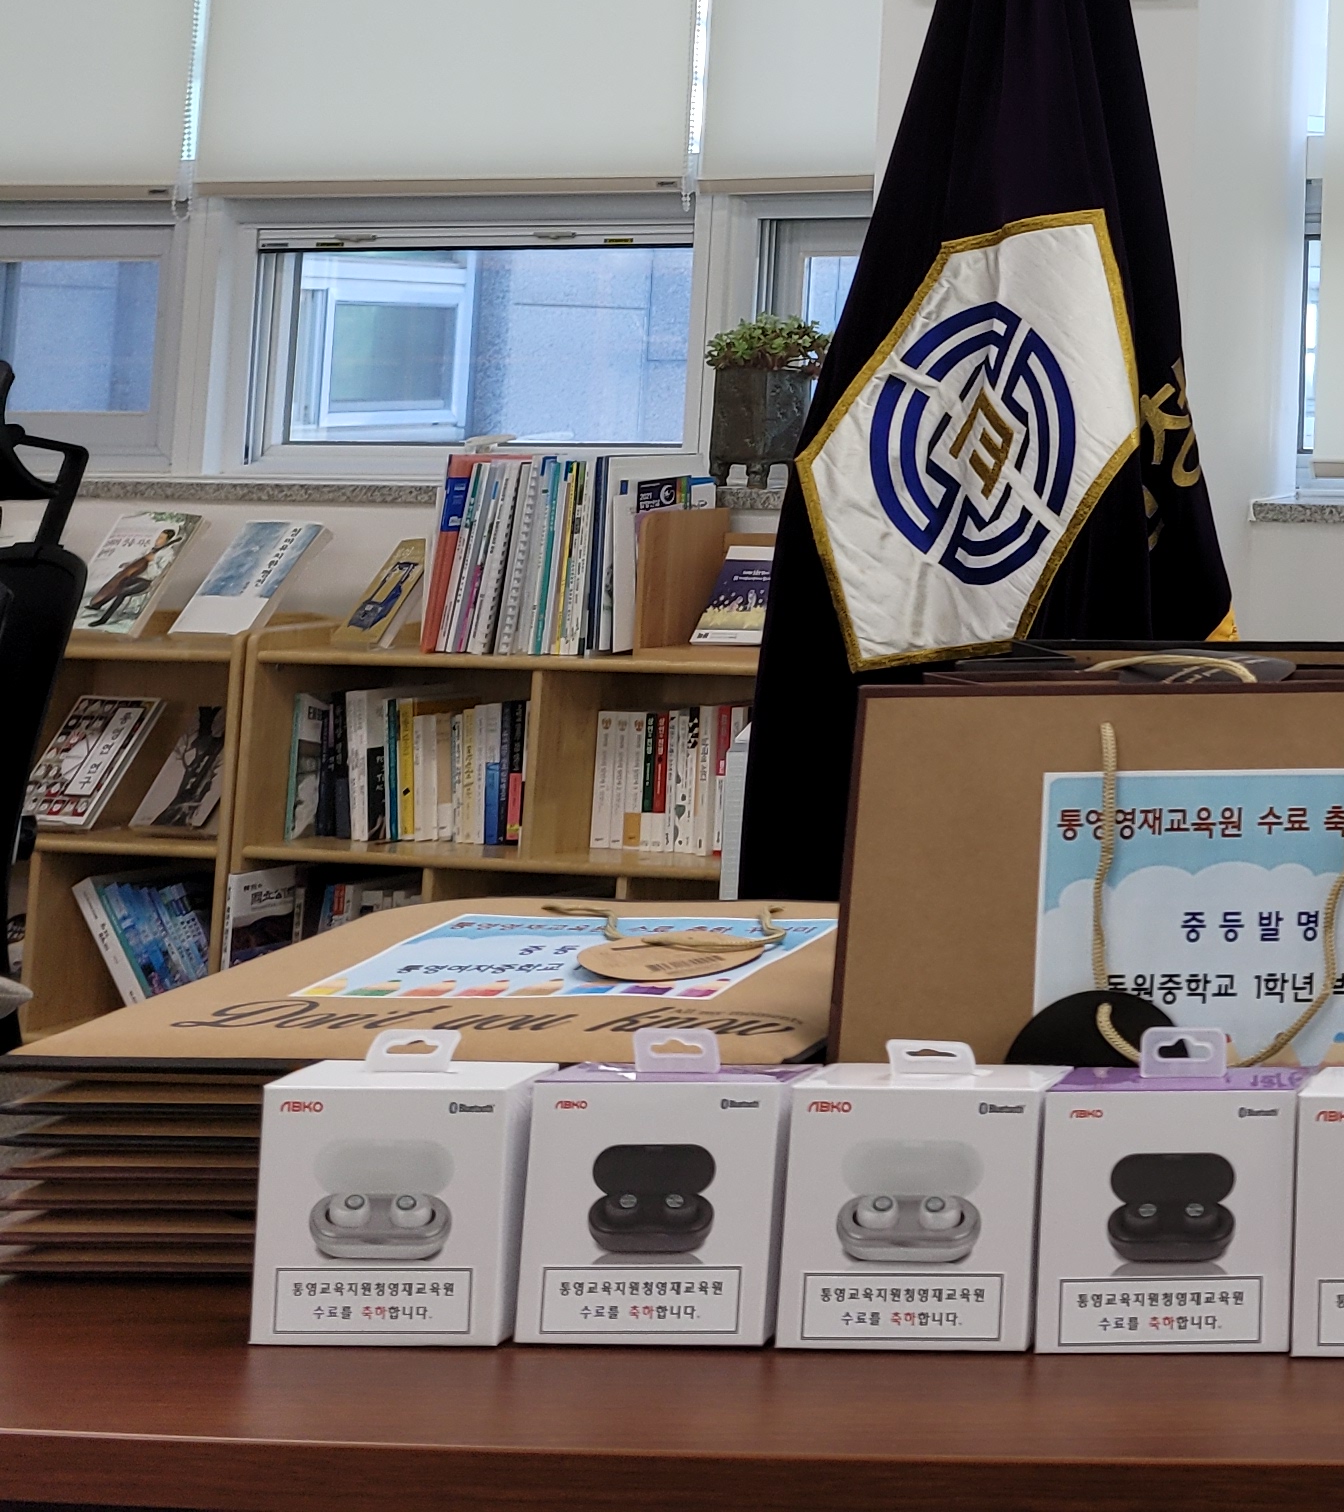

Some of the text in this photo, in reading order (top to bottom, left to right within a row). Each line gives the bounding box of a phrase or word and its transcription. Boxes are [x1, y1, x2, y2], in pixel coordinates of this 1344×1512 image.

[1256, 807, 1311, 838] 수료
[1254, 972, 1316, 1005] 1학년
[170, 999, 452, 1030] Don't
[584, 1006, 796, 1036] know
[279, 1100, 324, 1113] ABKO
[554, 1100, 588, 1110] ABKO
[807, 1100, 853, 1113] ABKO
[1069, 1109, 1104, 1119] ABKO
[292, 1281, 455, 1297] 통영교육지원청영재교육원
[558, 1280, 724, 1297] 통영교육지원청영재교육원
[820, 1287, 985, 1303] 통영교육지원청영재교육원
[1076, 1290, 1244, 1309] 통영교육지원청영재교육원
[312, 1305, 434, 1320] 수료를 축하합니다.
[579, 1304, 701, 1320] 수료를 축하합니다.
[840, 1311, 963, 1327] 수료를 축하합니다.
[1097, 1315, 1223, 1332] 수료를 축하합니다.
